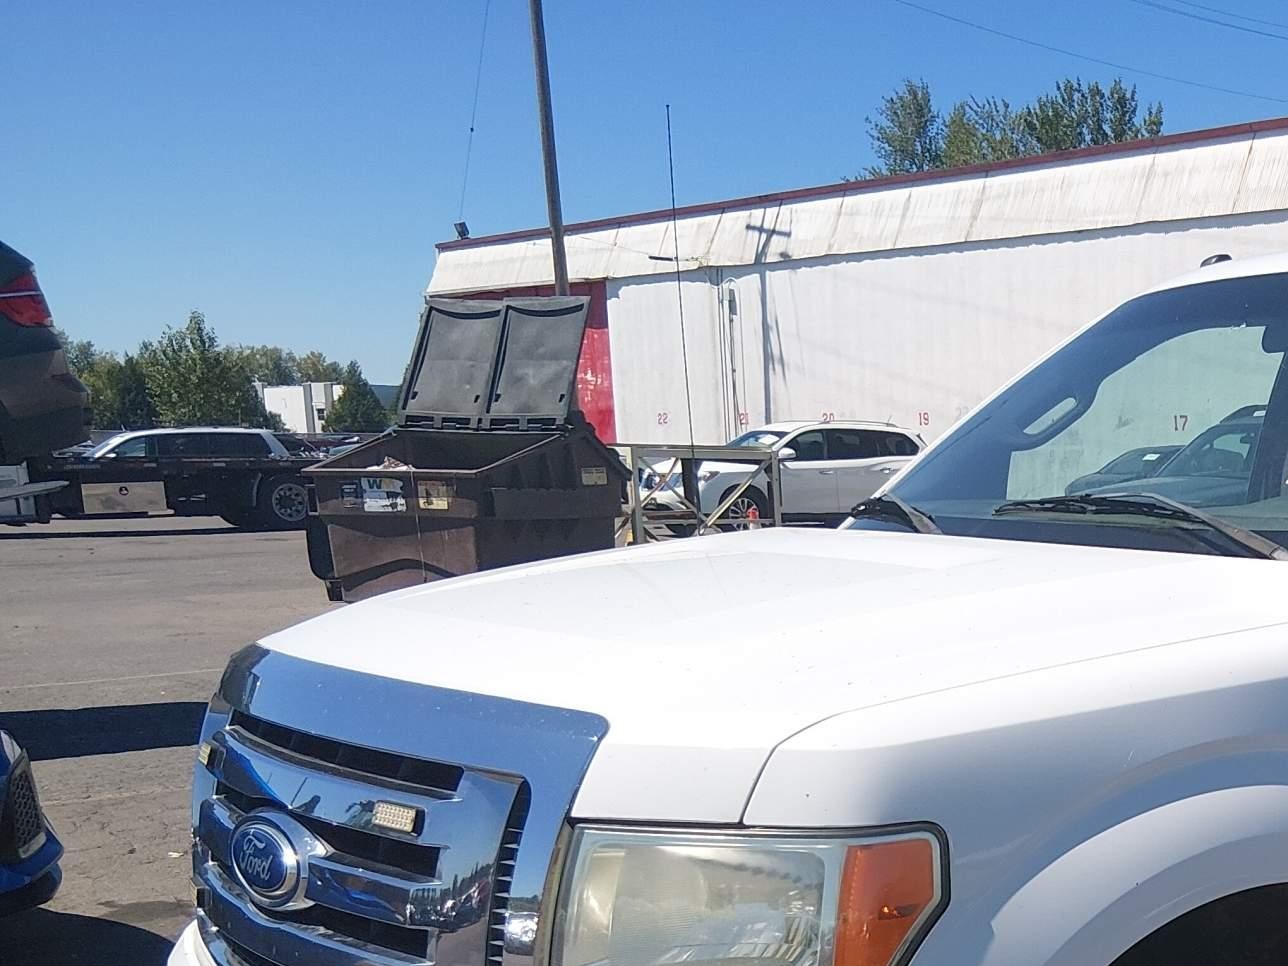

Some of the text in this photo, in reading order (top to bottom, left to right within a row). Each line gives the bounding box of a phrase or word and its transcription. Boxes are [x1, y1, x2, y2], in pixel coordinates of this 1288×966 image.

[657, 412, 668, 425] 22
[918, 412, 929, 426] 19
[1173, 415, 1188, 431] 17
[240, 829, 273, 880] Ford
